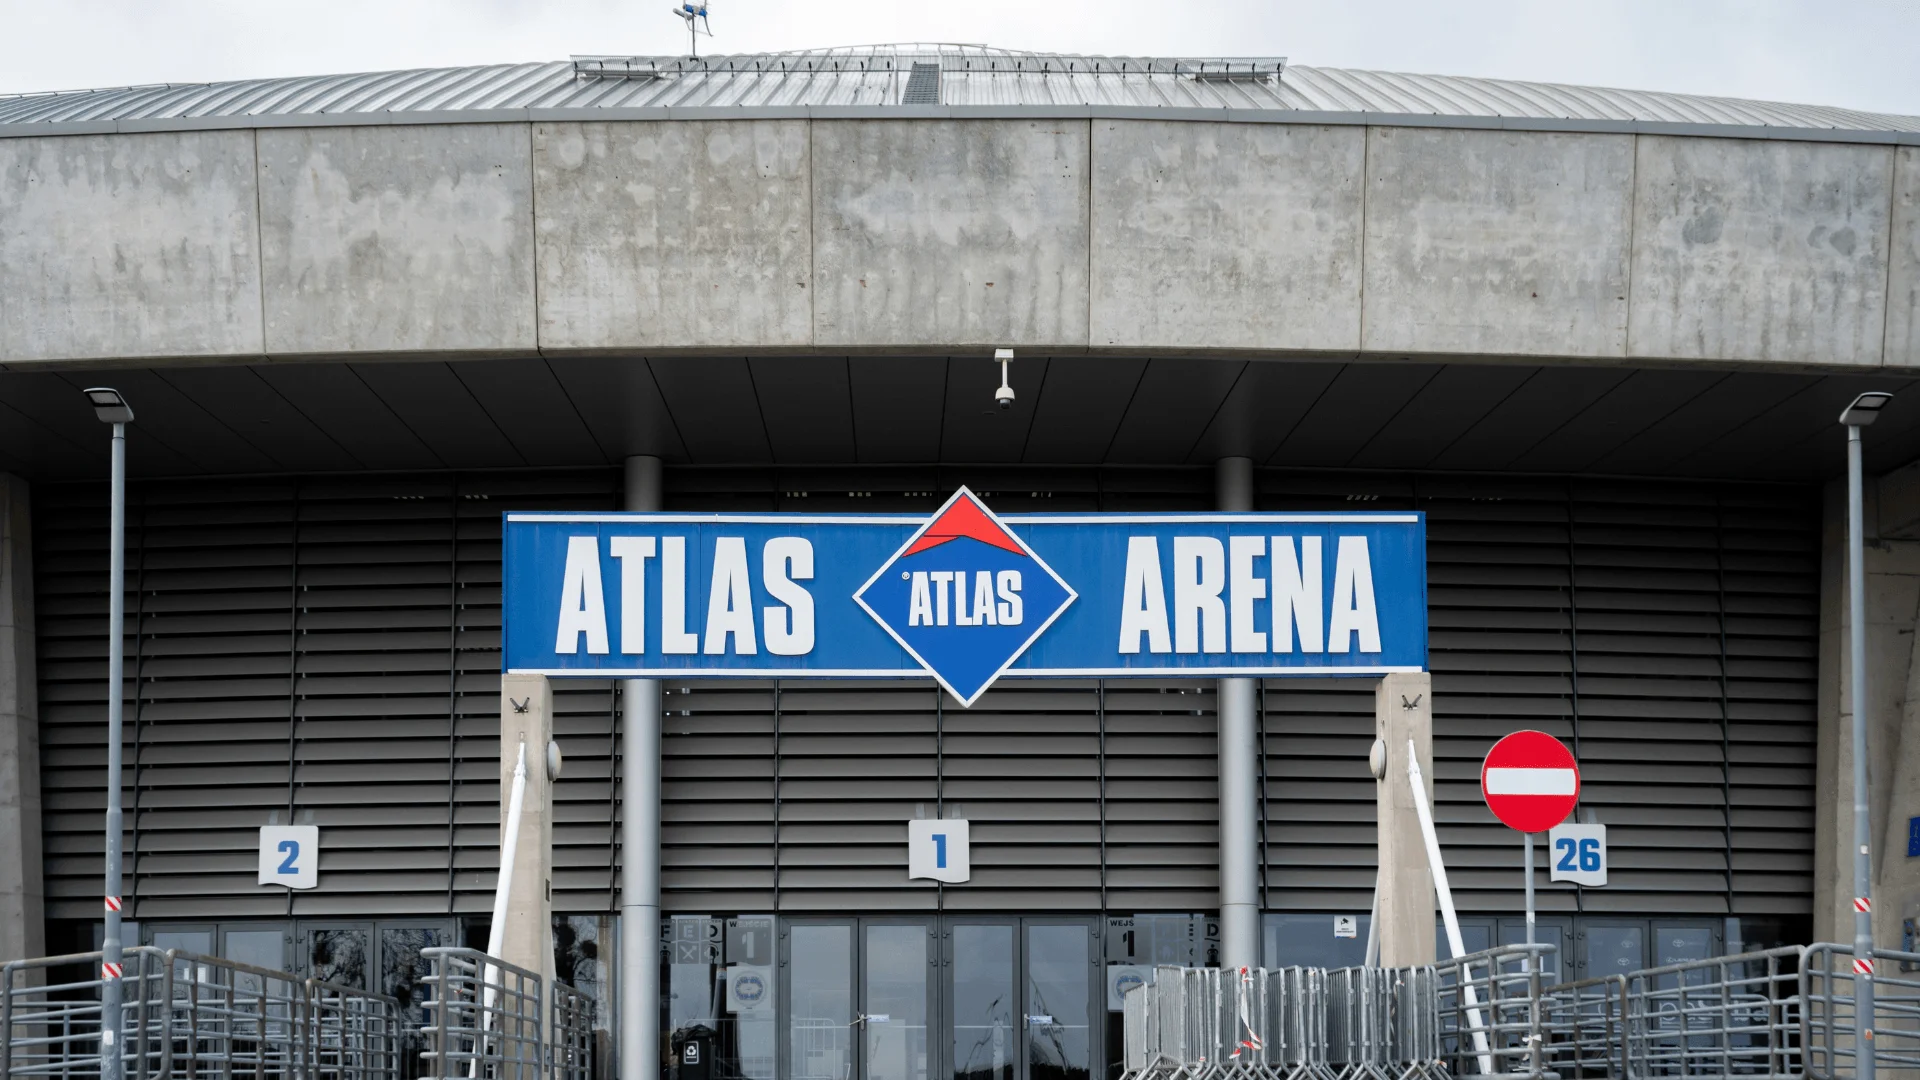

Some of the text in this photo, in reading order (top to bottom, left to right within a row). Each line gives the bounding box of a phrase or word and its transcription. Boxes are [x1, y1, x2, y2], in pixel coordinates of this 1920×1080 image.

[555, 535, 1381, 656] ATLAS ARENA
[909, 570, 1023, 627] ATLAS
[277, 840, 300, 874] 2
[932, 834, 947, 869] 1
[1556, 838, 1601, 872] 26
[683, 925, 694, 938] E
[742, 931, 754, 958] 1
[1207, 924, 1218, 936] D
